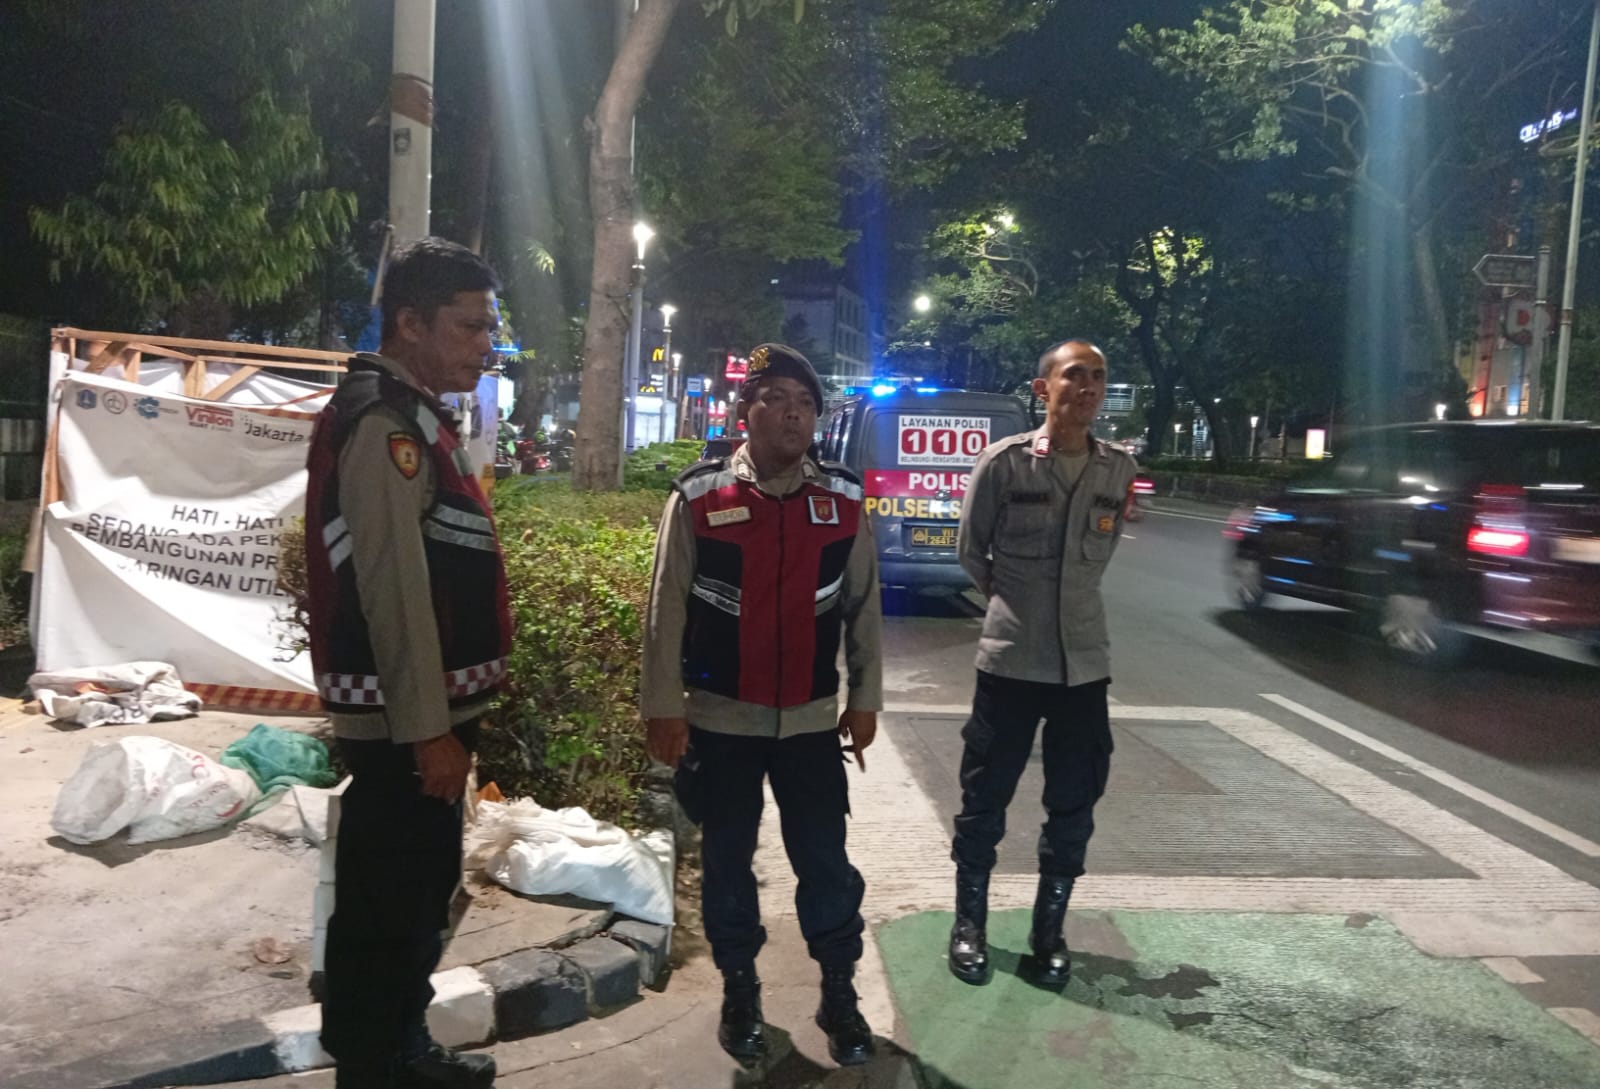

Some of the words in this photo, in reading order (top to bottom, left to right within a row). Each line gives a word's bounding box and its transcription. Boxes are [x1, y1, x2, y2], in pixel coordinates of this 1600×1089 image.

[901, 417, 951, 428] LAYANAN
[954, 419, 988, 429] POLISI
[907, 431, 982, 454] 110
[909, 473, 970, 490] POLIS
[171, 504, 219, 526] HATI
[235, 514, 284, 531] HATI
[71, 522, 245, 567] PEMBANGUNAN
[251, 553, 279, 571] PR
[188, 532, 234, 546] ADA
[240, 535, 282, 547] PEK
[238, 577, 285, 597] UTIL
